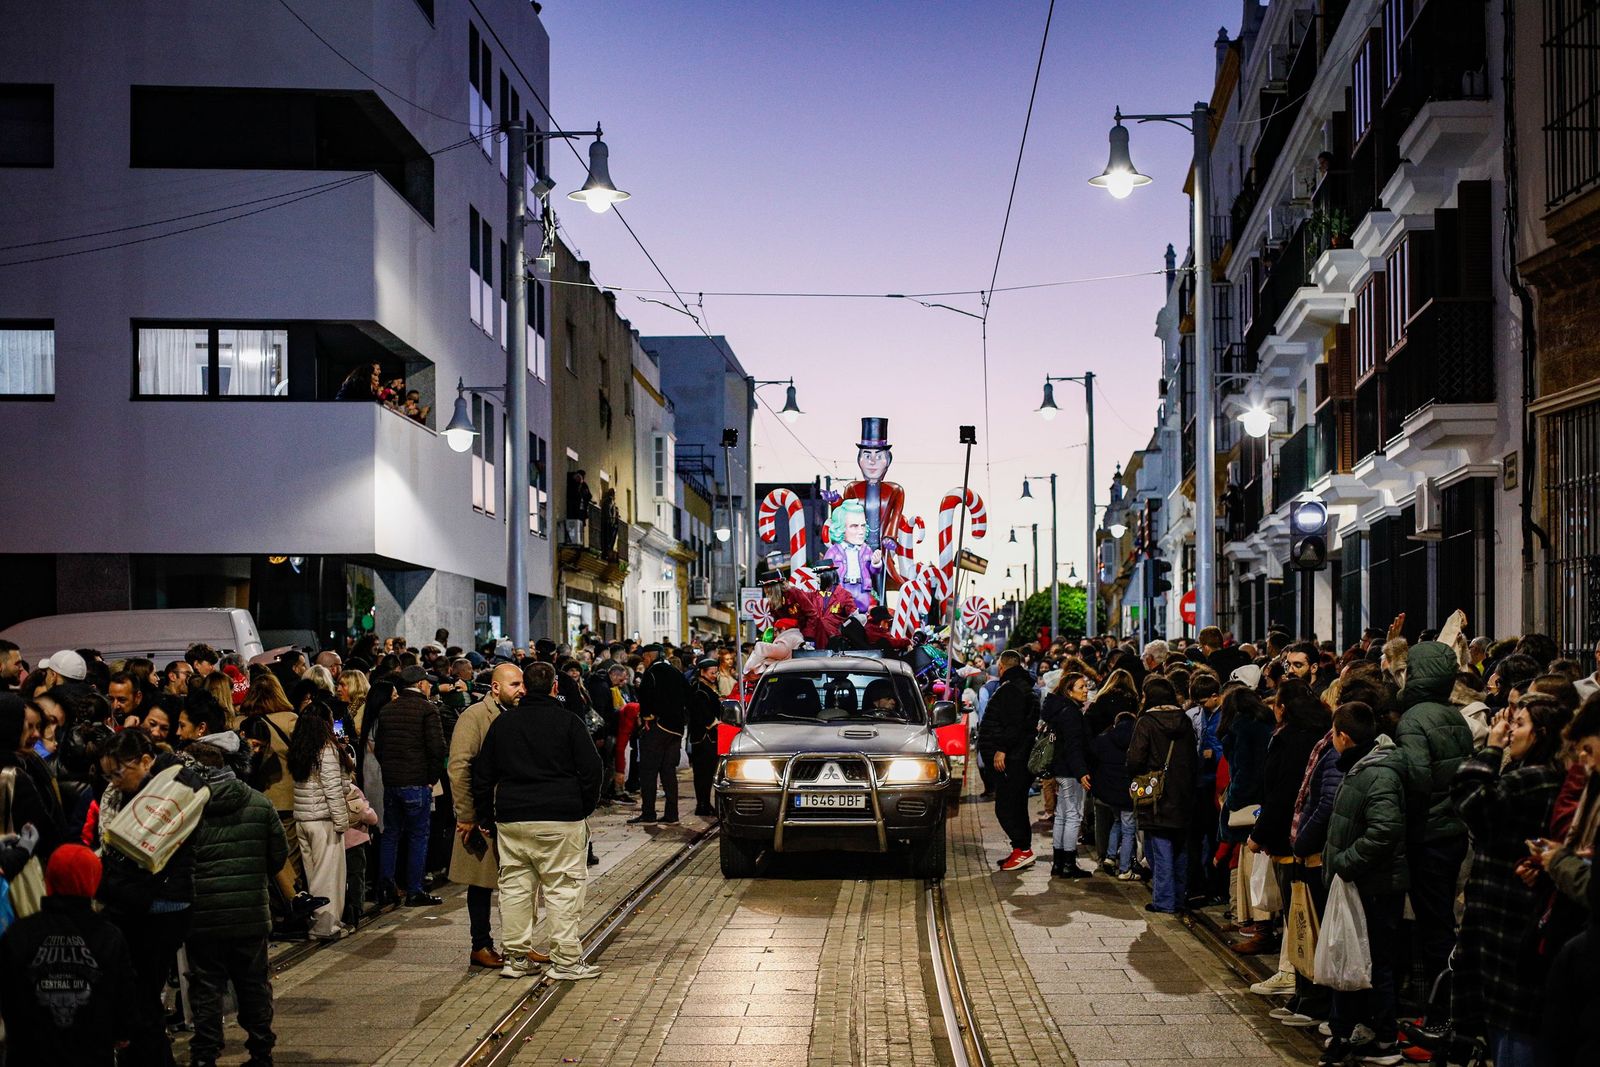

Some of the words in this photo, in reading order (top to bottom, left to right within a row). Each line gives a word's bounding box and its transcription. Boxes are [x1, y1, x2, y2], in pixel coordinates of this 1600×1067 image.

[805, 795, 835, 806] 1646
[838, 795, 862, 806] DBF
[43, 935, 85, 945] CHICAGO
[31, 946, 98, 968] BULLS
[40, 979, 70, 989] CENTRAL
[73, 979, 84, 988] DIV
